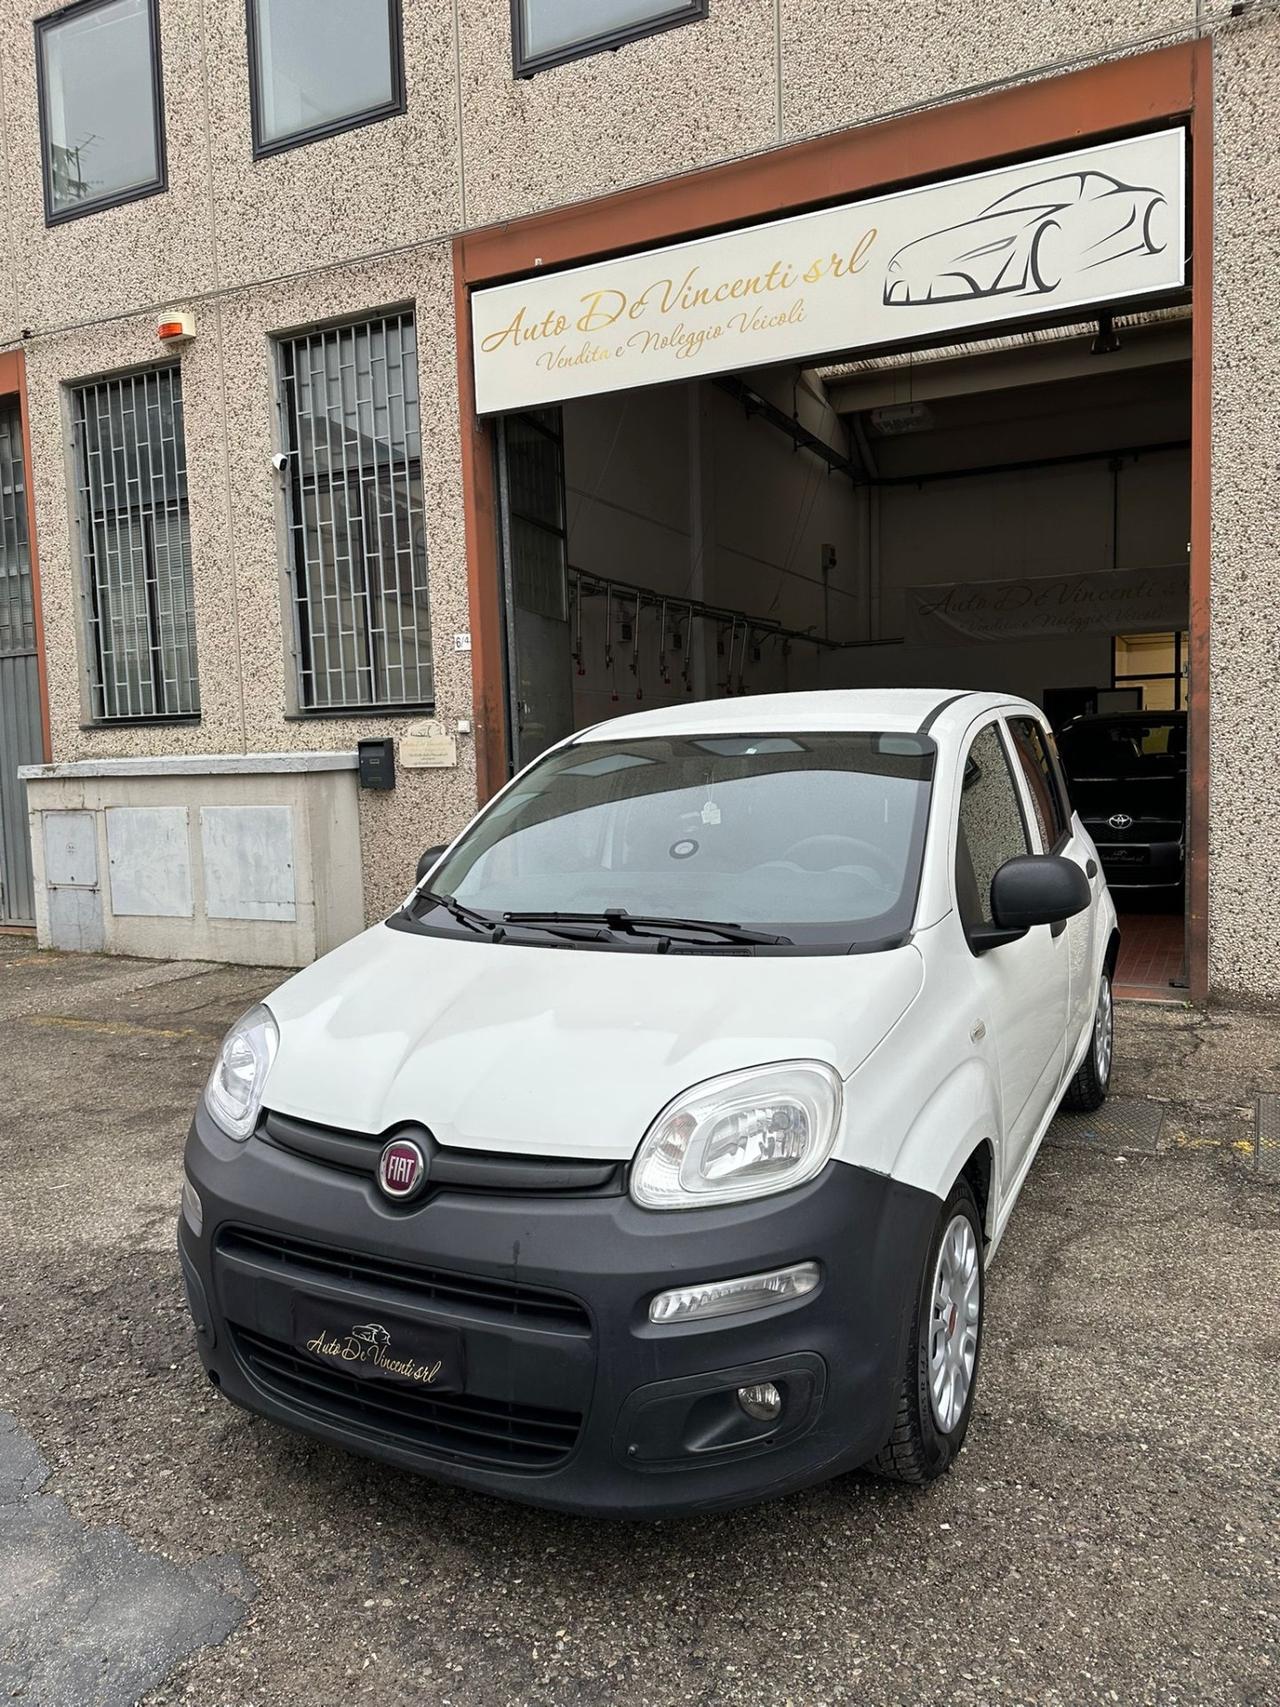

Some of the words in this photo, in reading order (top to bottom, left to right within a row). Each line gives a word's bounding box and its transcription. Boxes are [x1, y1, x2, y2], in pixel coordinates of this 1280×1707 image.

[481, 306, 571, 352] Auto
[576, 289, 648, 332] De
[642, 260, 797, 313] Vincenti
[802, 228, 878, 283] srl
[536, 341, 609, 371] Vendita
[615, 346, 625, 357] e
[627, 323, 724, 359] Noleggio
[727, 298, 806, 333] Veicoli
[388, 1156, 415, 1183] FIAT
[307, 1330, 341, 1356] Auto
[342, 1336, 366, 1361] De
[367, 1345, 414, 1377] Vincenti
[414, 1361, 442, 1383] srl
